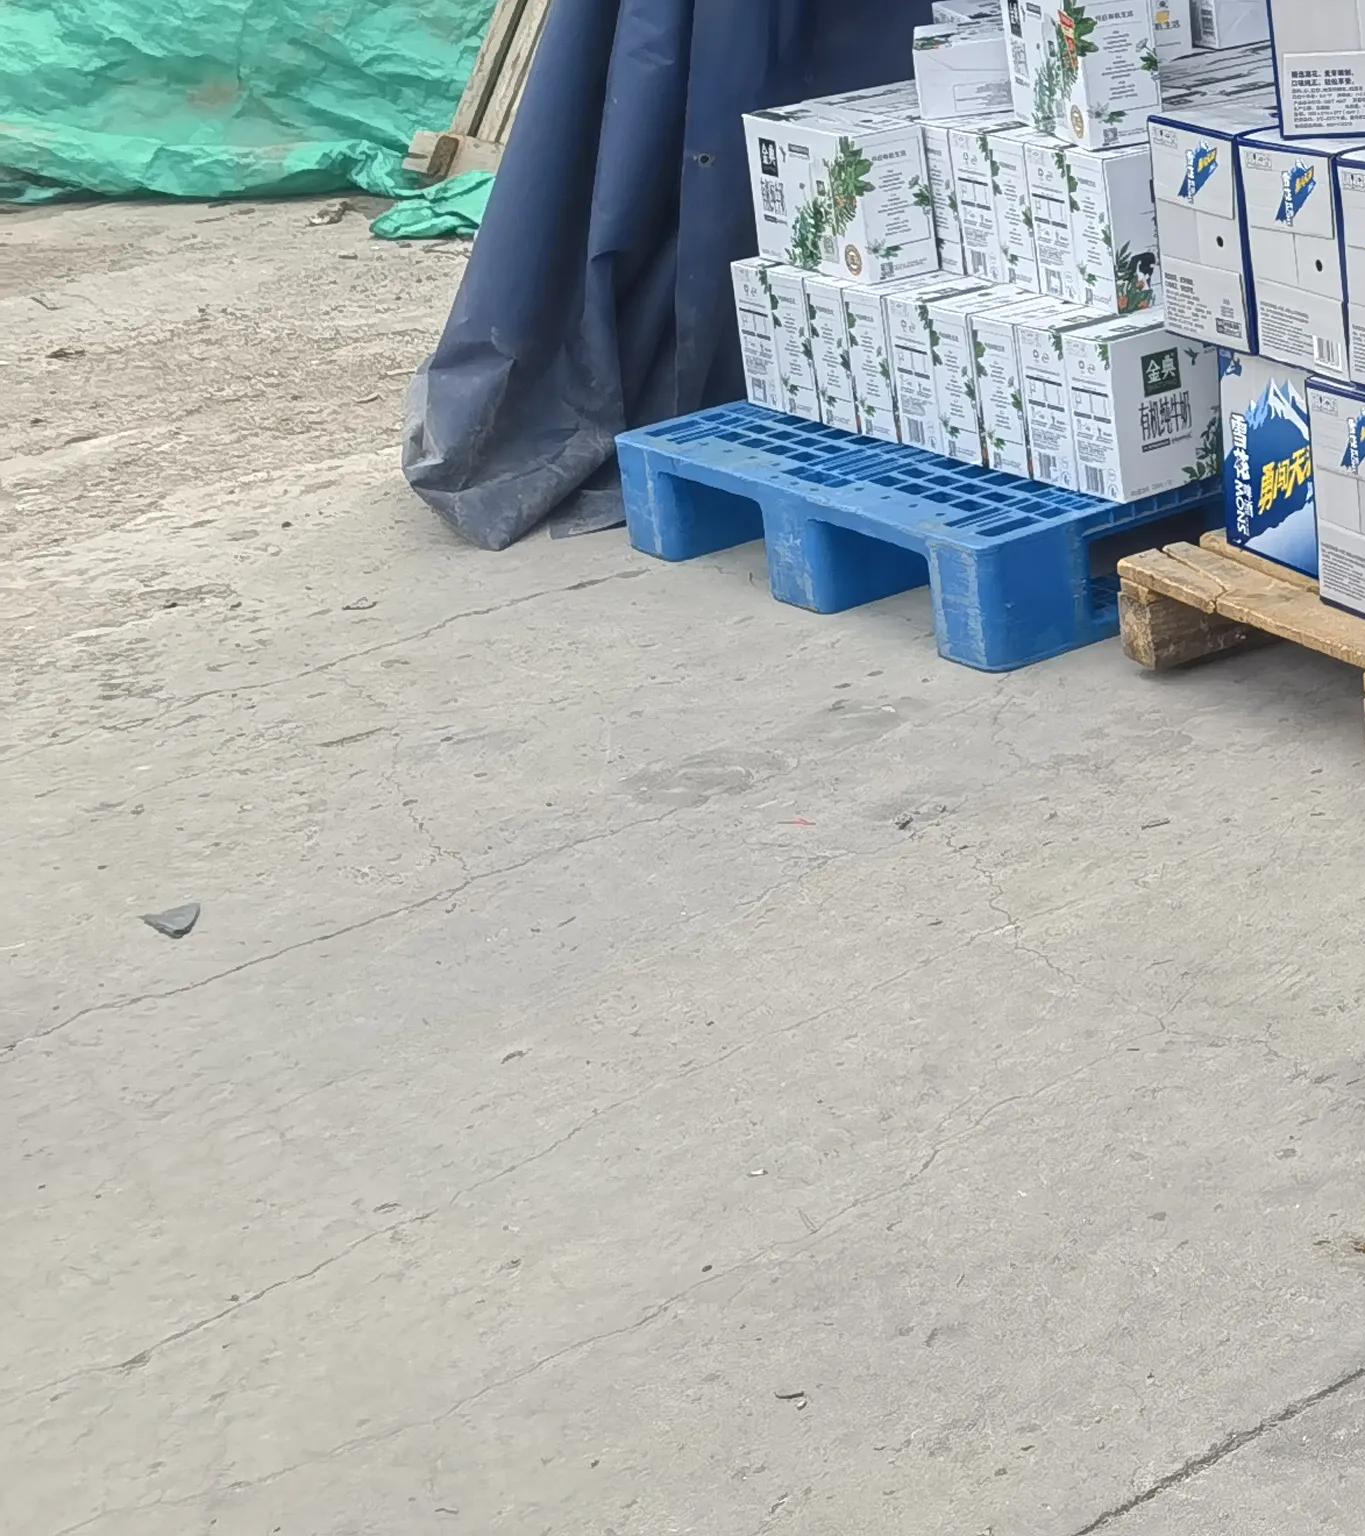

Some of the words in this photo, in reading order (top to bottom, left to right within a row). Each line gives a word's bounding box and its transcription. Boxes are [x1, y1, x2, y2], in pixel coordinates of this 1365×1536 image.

[1145, 354, 1177, 384] 金典
[1138, 390, 1192, 441] 有机纯牛奶
[1234, 478, 1249, 535] SNOW
